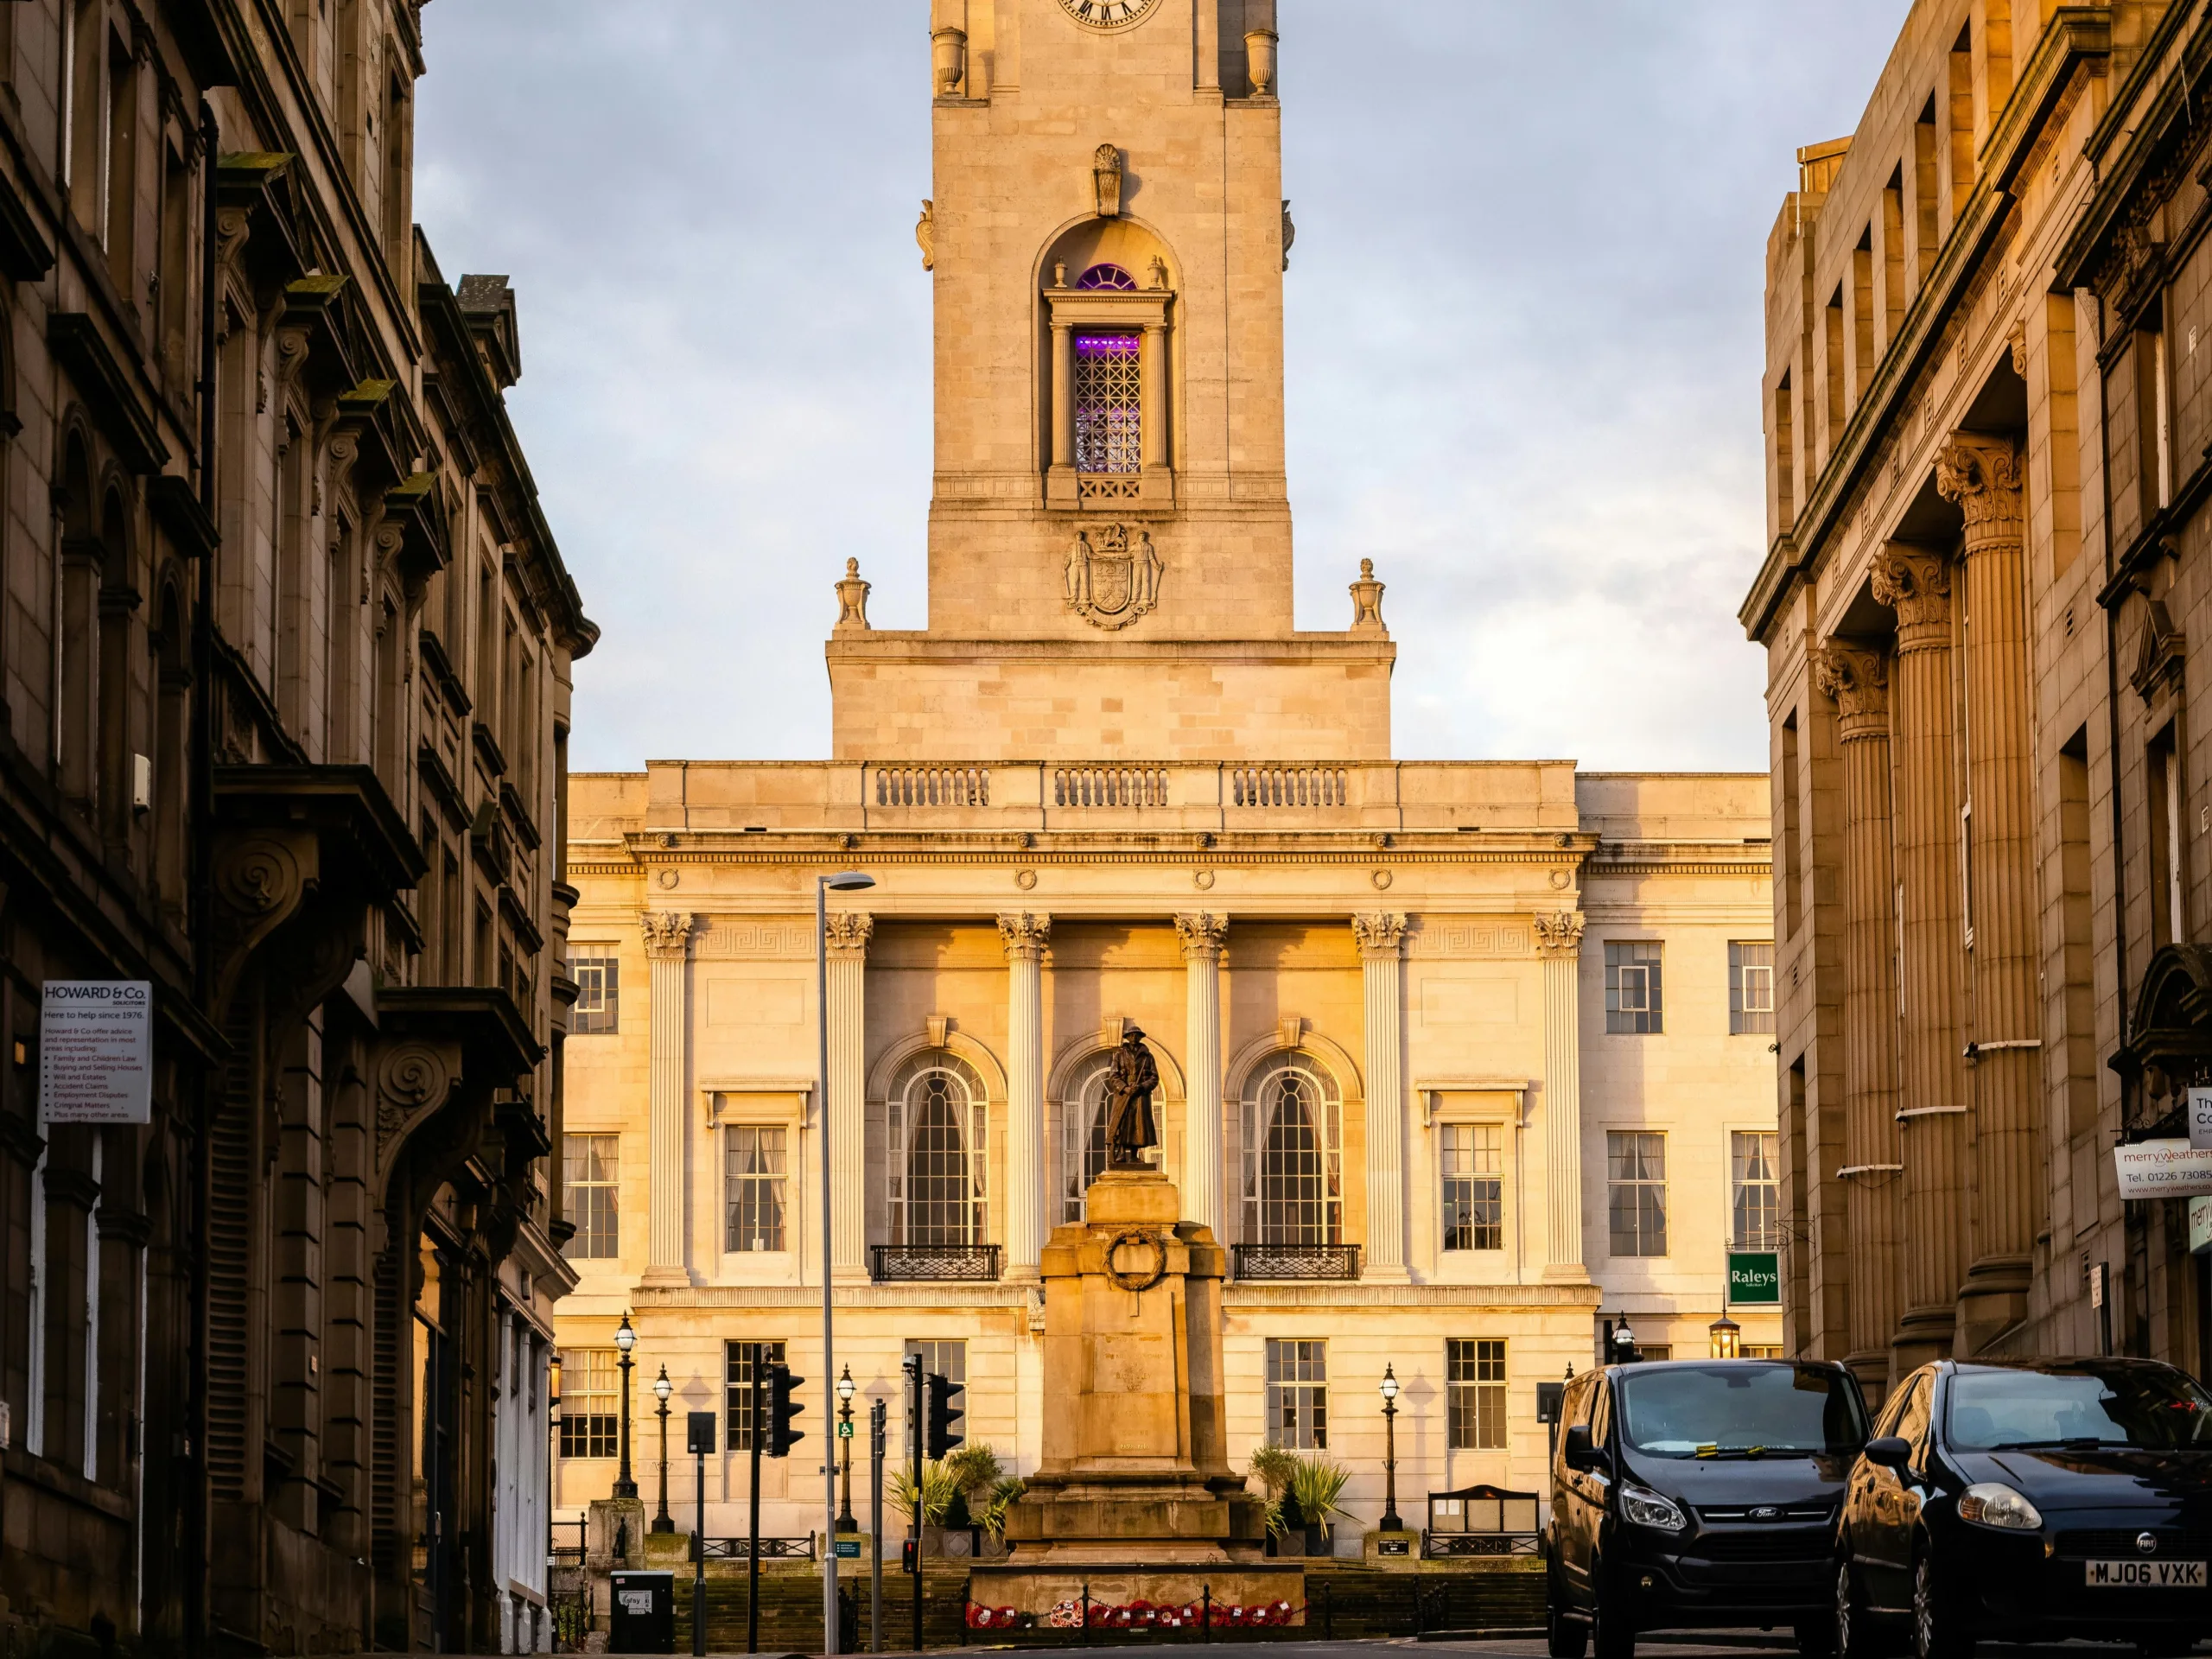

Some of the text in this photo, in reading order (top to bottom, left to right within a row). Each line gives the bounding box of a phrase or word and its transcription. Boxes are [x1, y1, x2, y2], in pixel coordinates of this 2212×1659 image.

[45, 987, 146, 999] HOWARD & Co.
[78, 1012, 97, 1020] help
[2126, 1173, 2144, 1182] Tel.
[2148, 1172, 2177, 1182] 01226
[1732, 1268, 1777, 1287] Raleys
[1757, 1509, 1777, 1517] Ford
[2139, 1539, 2155, 1548] FIAT
[2096, 1563, 2198, 1583] MJ06 VXK
